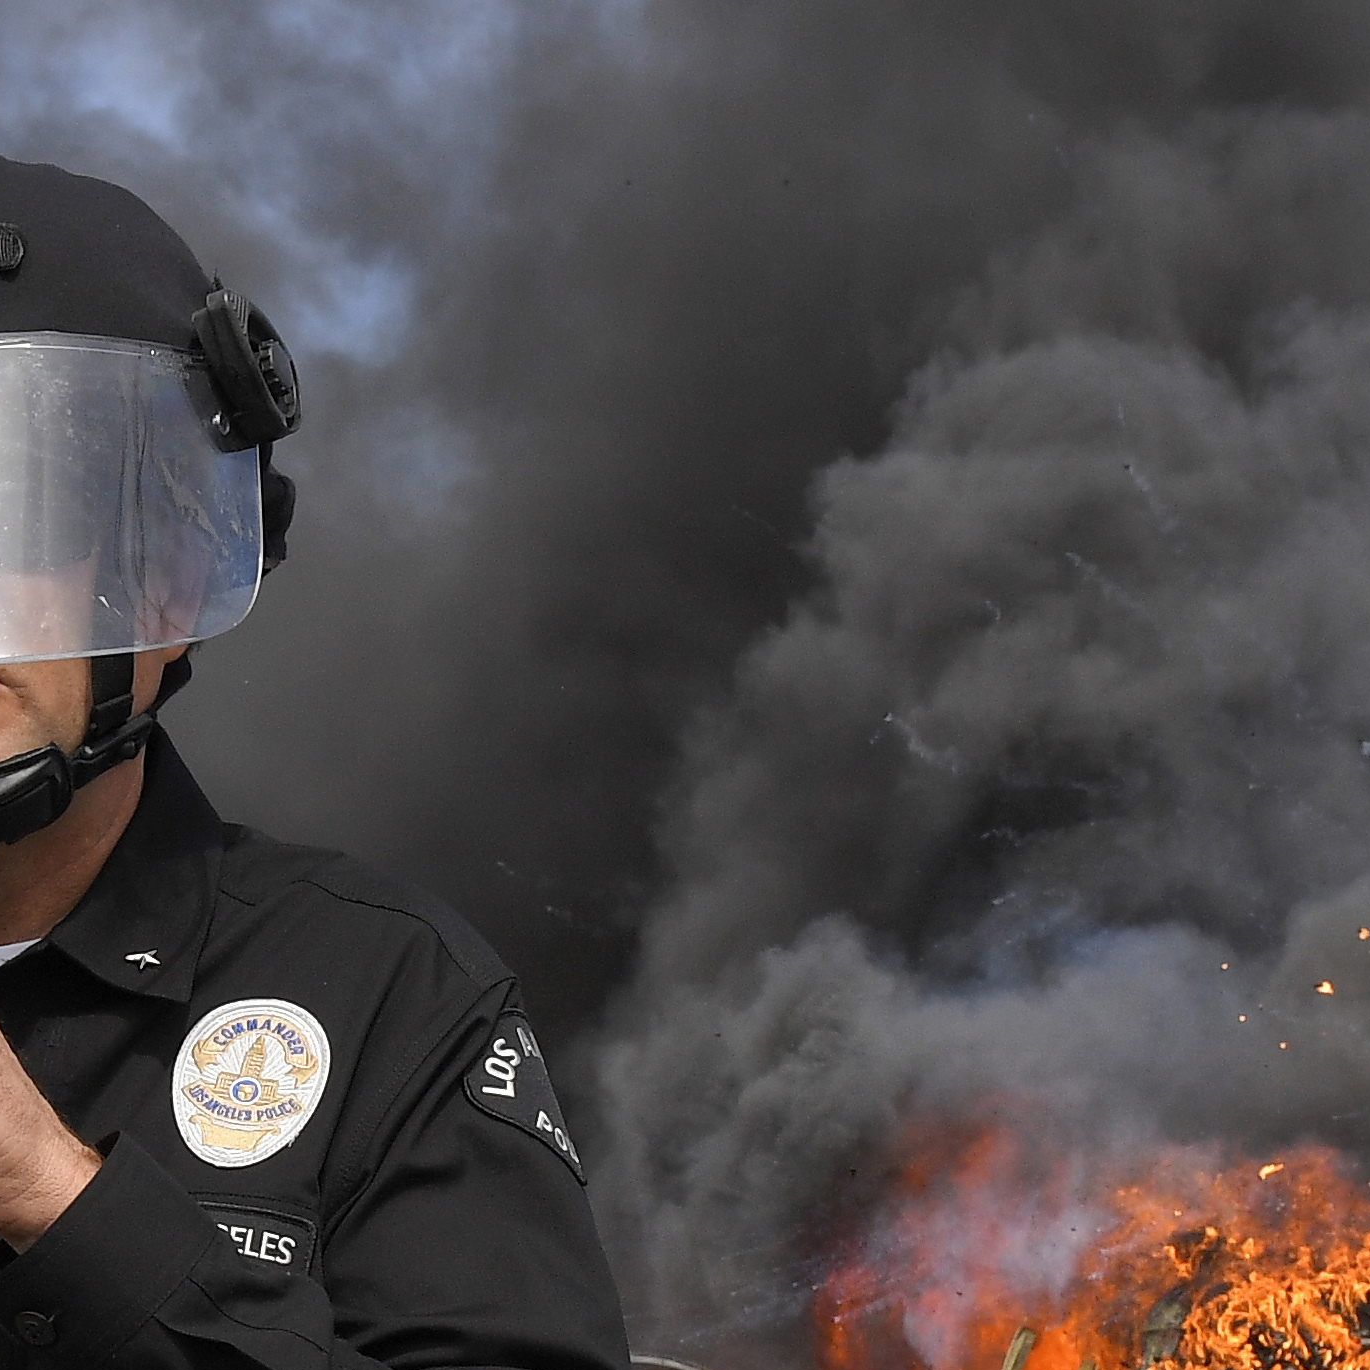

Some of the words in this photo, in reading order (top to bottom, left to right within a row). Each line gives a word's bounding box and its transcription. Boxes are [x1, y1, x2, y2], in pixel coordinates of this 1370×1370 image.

[213, 1018, 304, 1056] COMMANDER
[481, 1037, 521, 1098] LOS
[203, 1098, 252, 1121] ANGELES
[256, 1099, 300, 1121] POLICE
[216, 1223, 297, 1265] ELES
